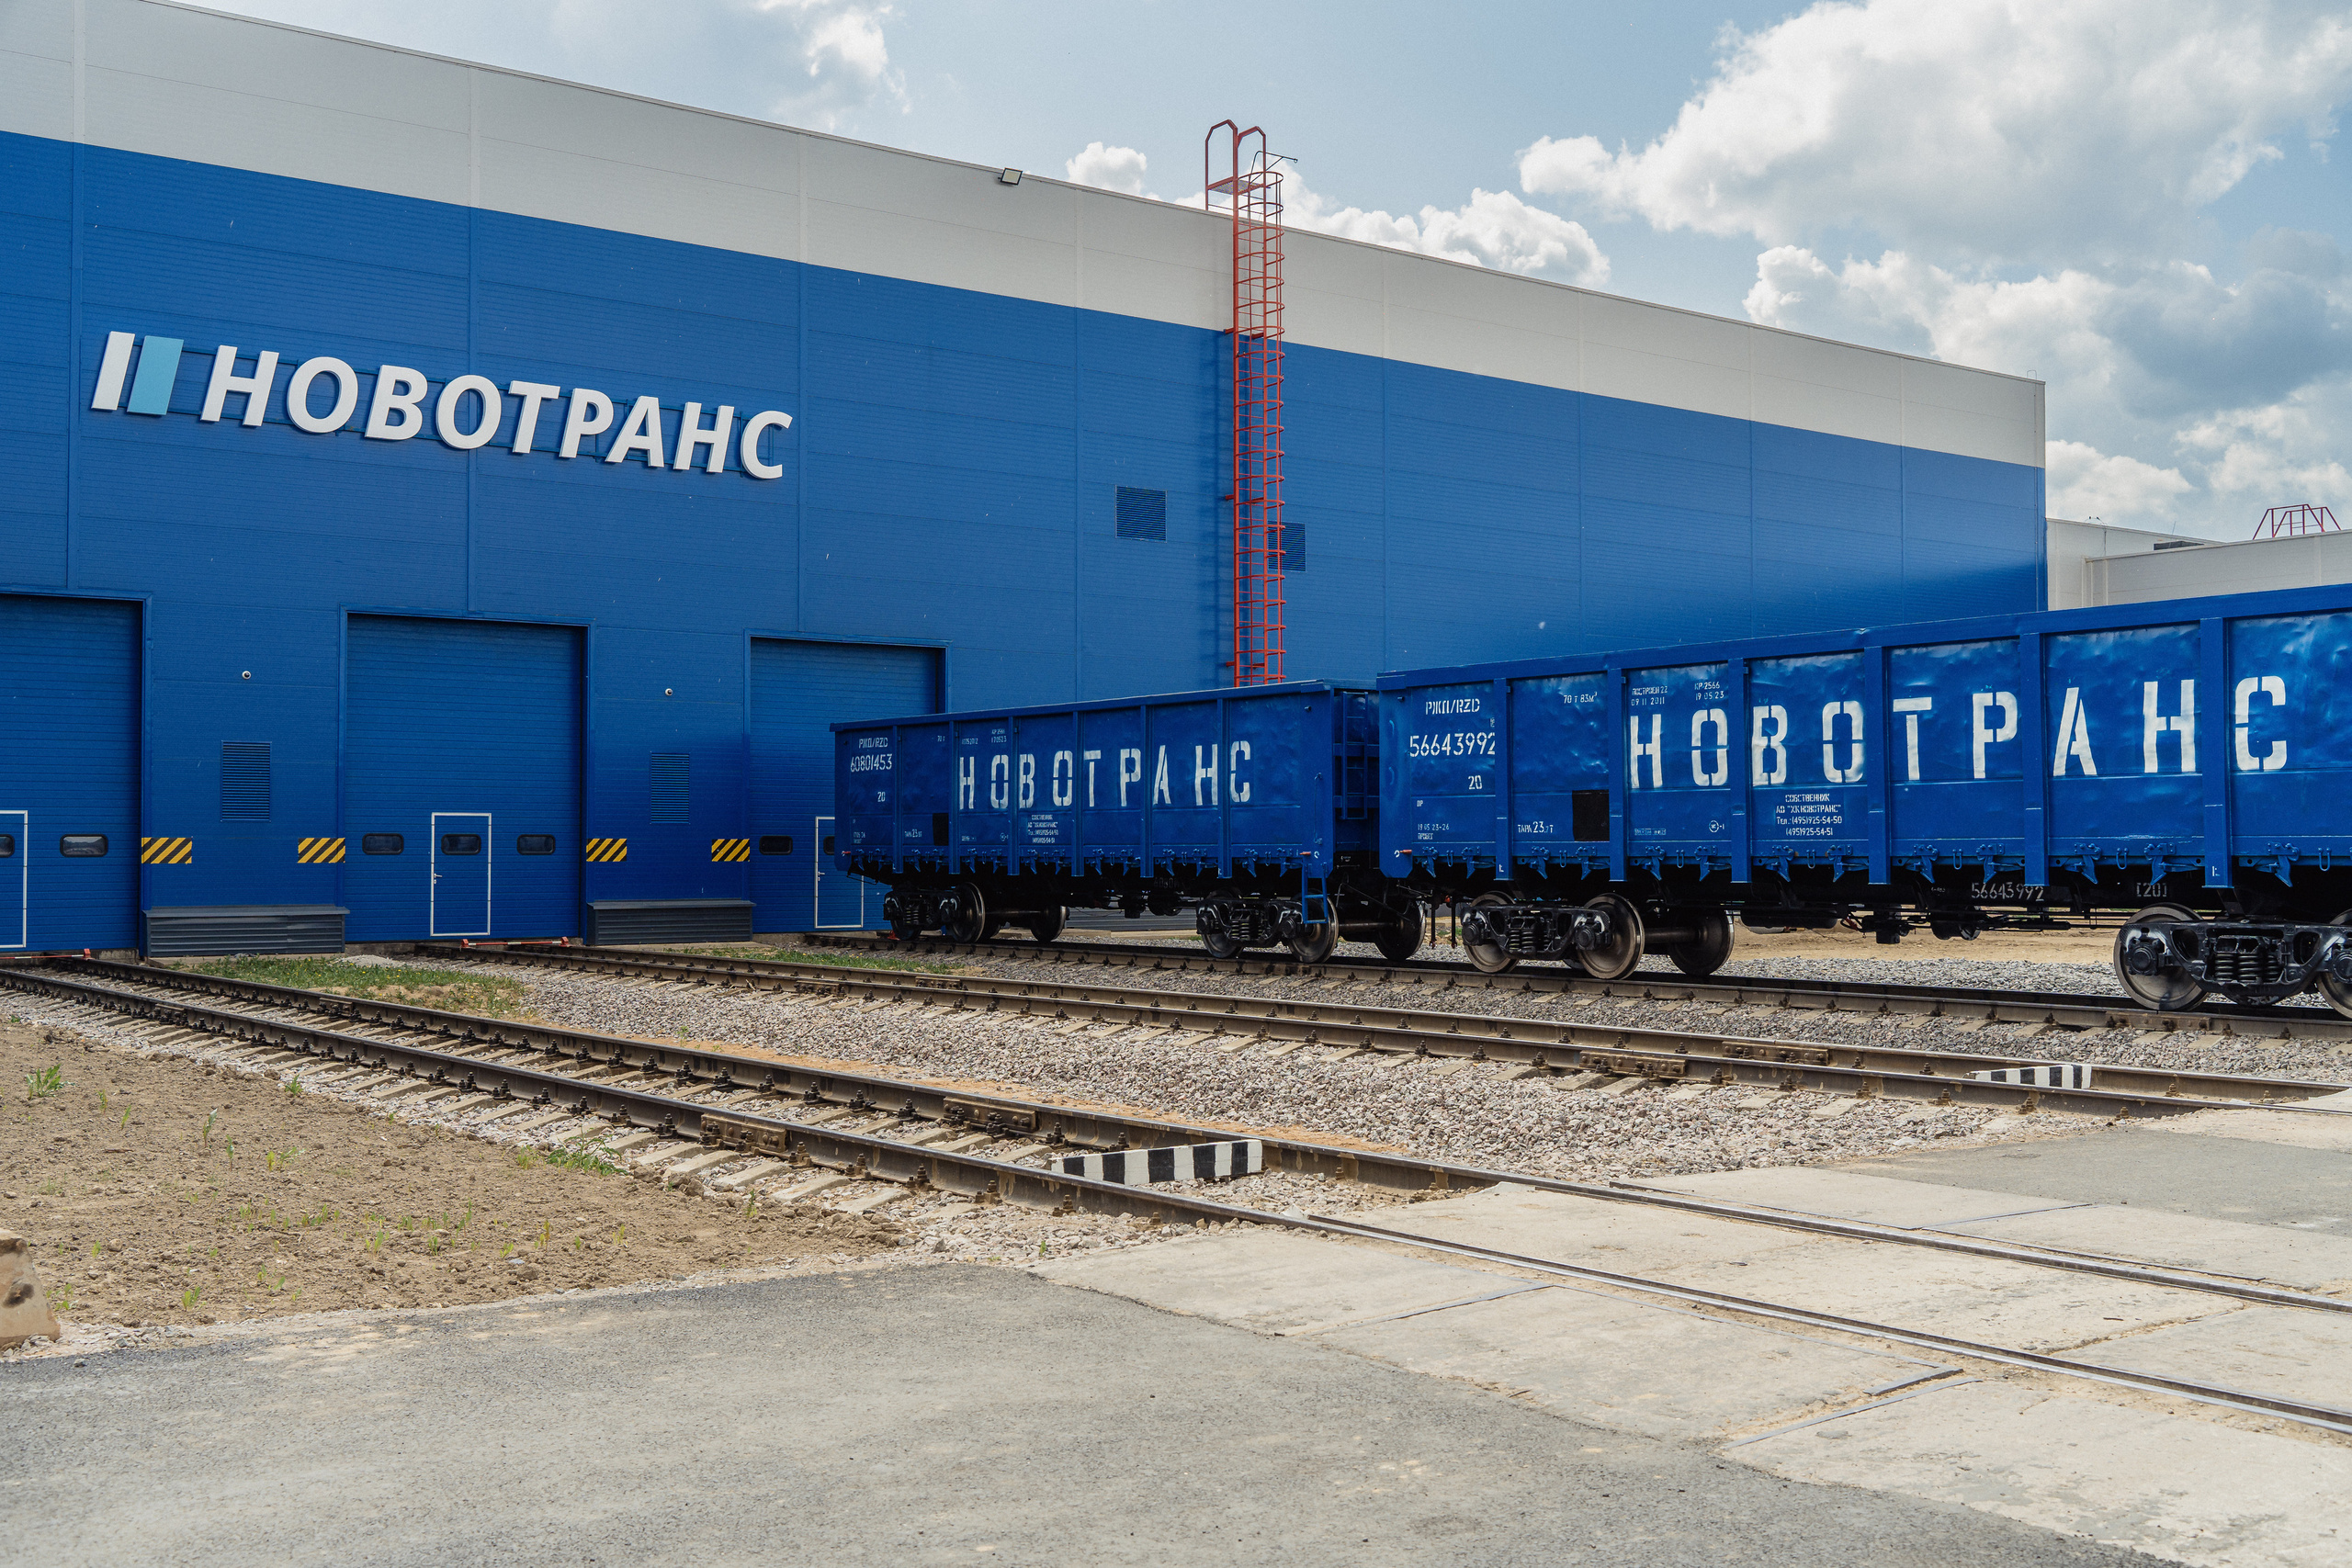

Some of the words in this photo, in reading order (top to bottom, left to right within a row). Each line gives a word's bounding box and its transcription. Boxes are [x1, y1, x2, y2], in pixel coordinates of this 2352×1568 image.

[199, 344, 793, 479] НОВОТРАНС
[1563, 694, 1572, 704] 70
[1630, 675, 2288, 789] НОВОТРАНС
[1409, 732, 1496, 758] 56643992
[850, 753, 893, 773] 60801453
[959, 740, 1251, 809] НОВОТРАНС
[1467, 774, 1483, 790] 20
[876, 791, 886, 802] 20
[1971, 882, 2045, 902] 56643992
